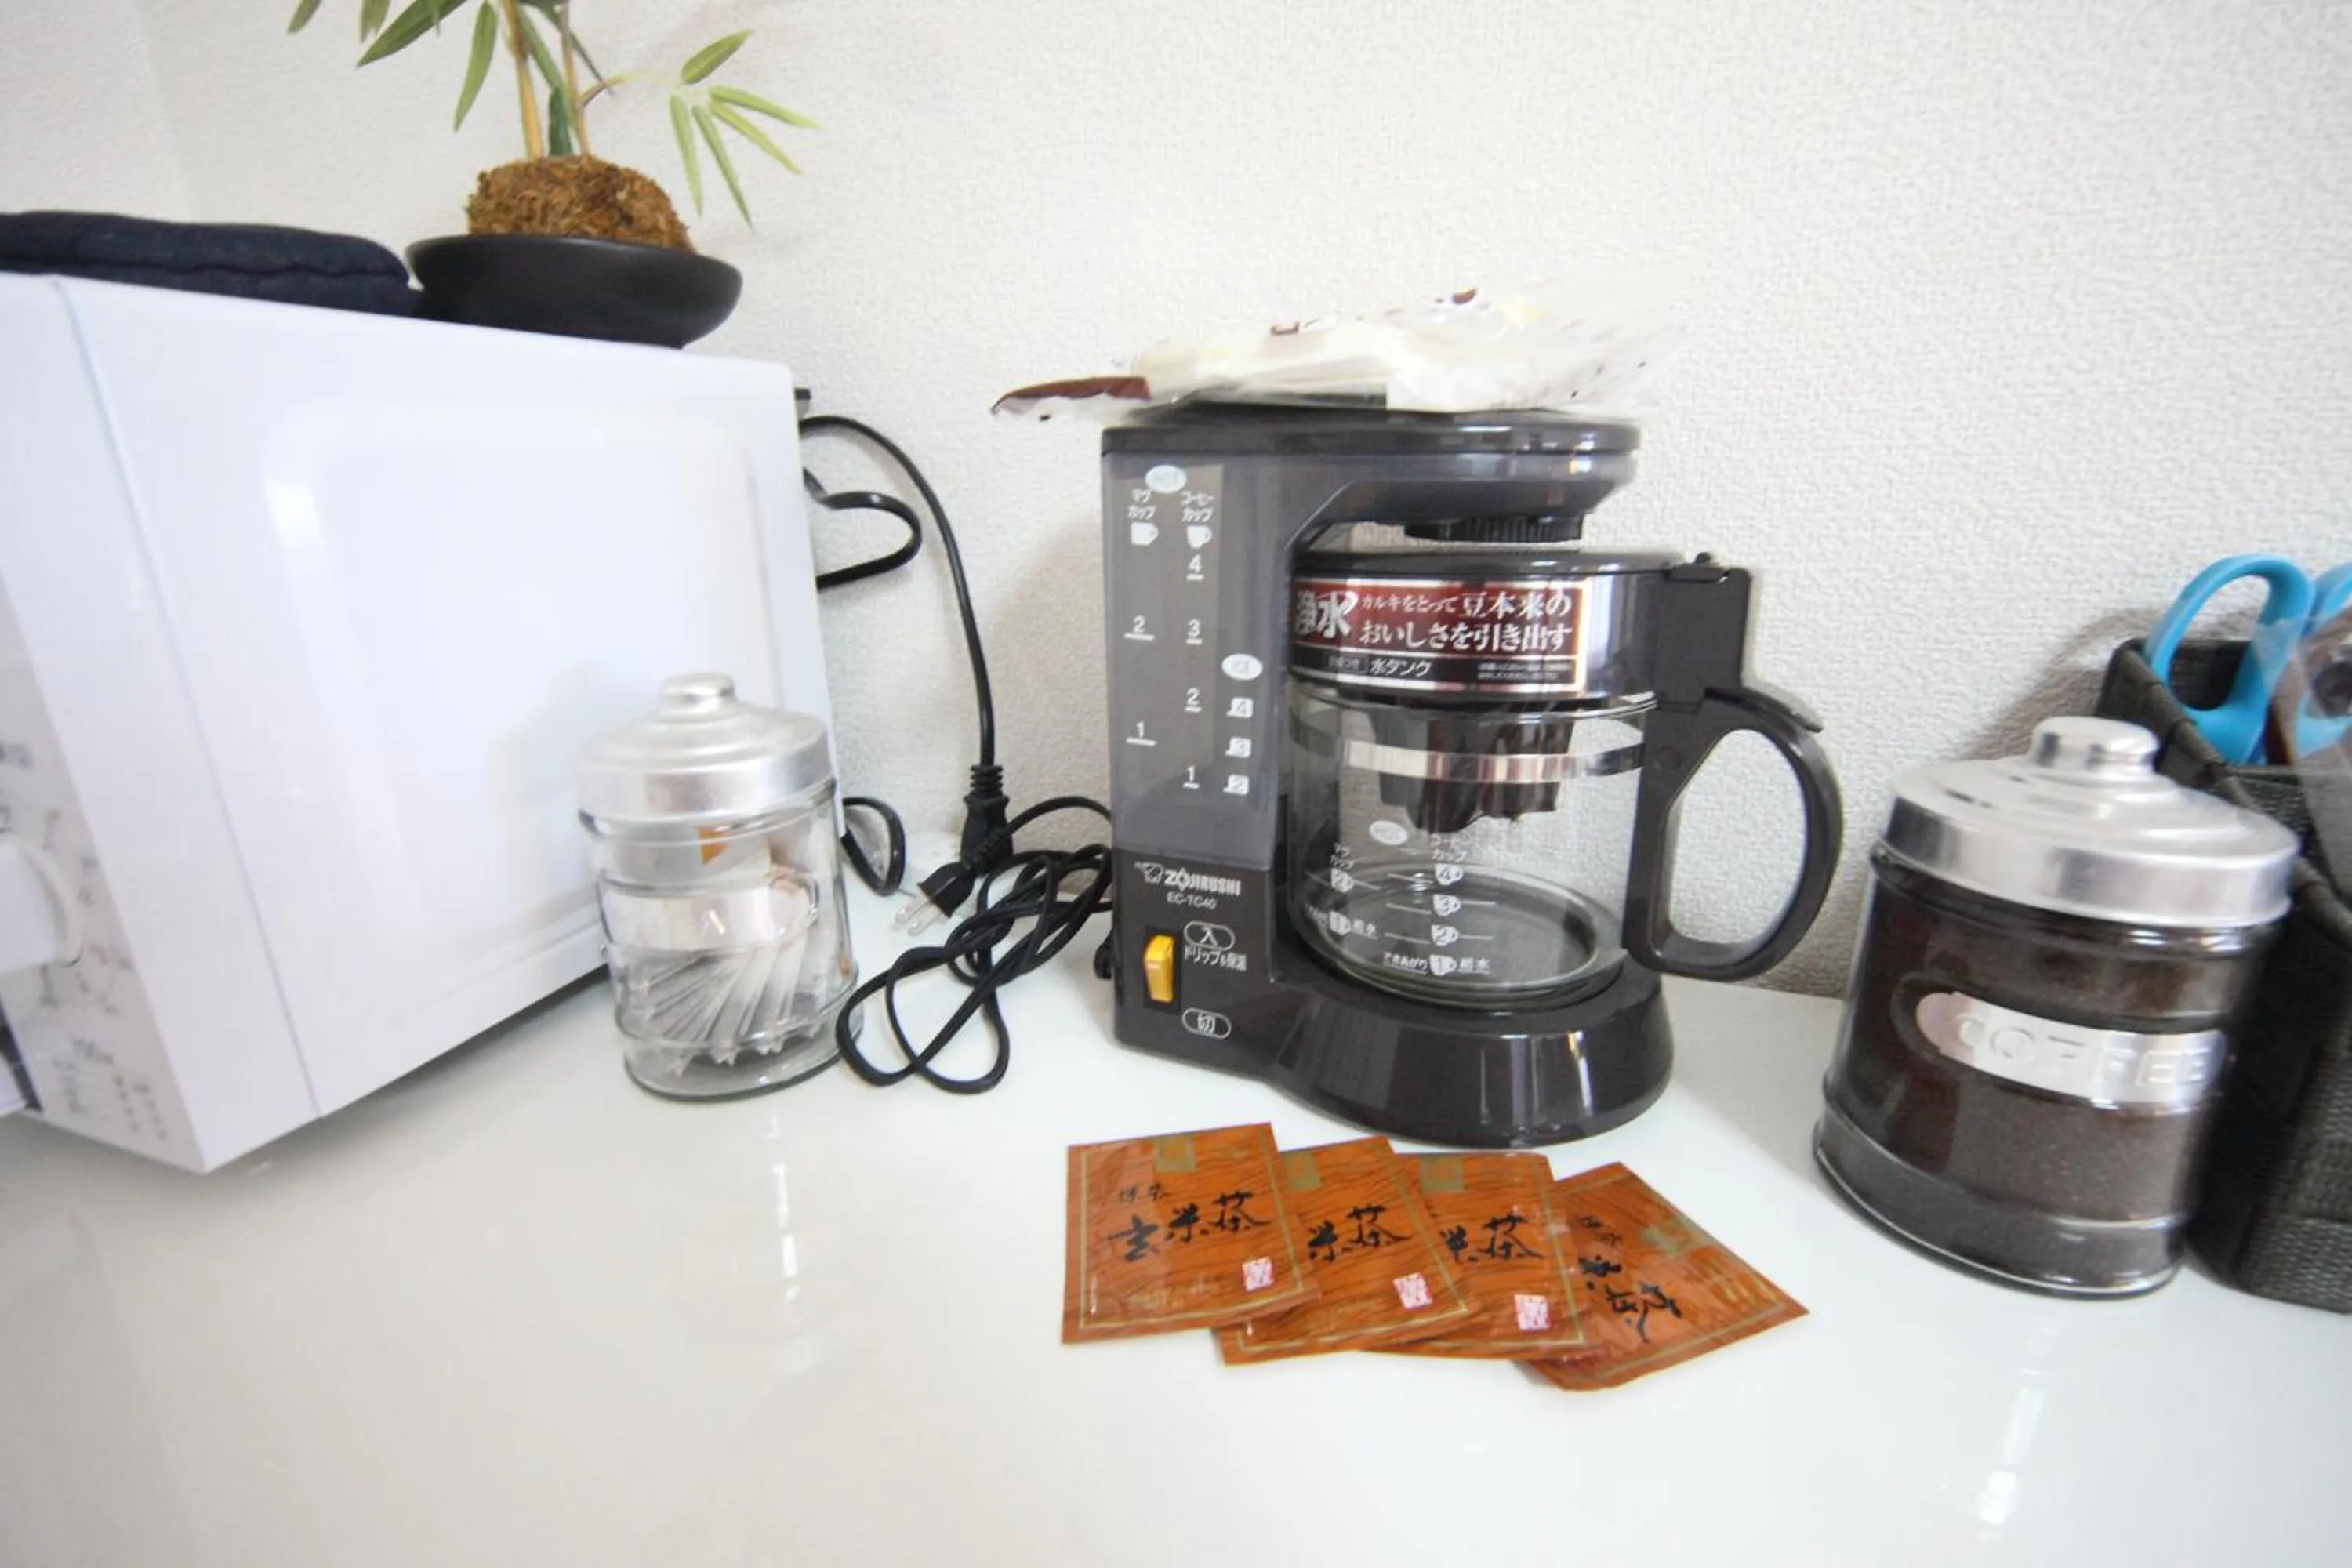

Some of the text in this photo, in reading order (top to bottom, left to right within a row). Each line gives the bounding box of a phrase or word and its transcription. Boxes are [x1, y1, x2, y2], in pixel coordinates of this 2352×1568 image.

[1181, 491, 1215, 506] コーヒー
[1189, 555, 1203, 573] 4
[1362, 591, 1573, 619] カルキをとって 豆本来の
[1134, 615, 1145, 633] 2
[1189, 619, 1201, 637] 3
[1359, 619, 1573, 652] おいしさを引き出す
[1186, 688, 1199, 705] 2
[1137, 721, 1145, 739] 1
[1187, 766, 1195, 782] 1
[1165, 867, 1242, 896] ZOJIRUSHI
[1167, 891, 1217, 910] EC-TC40
[1199, 927, 1218, 948] 入
[1197, 1014, 1217, 1036] 切
[1958, 1011, 2212, 1087] COFFEE
